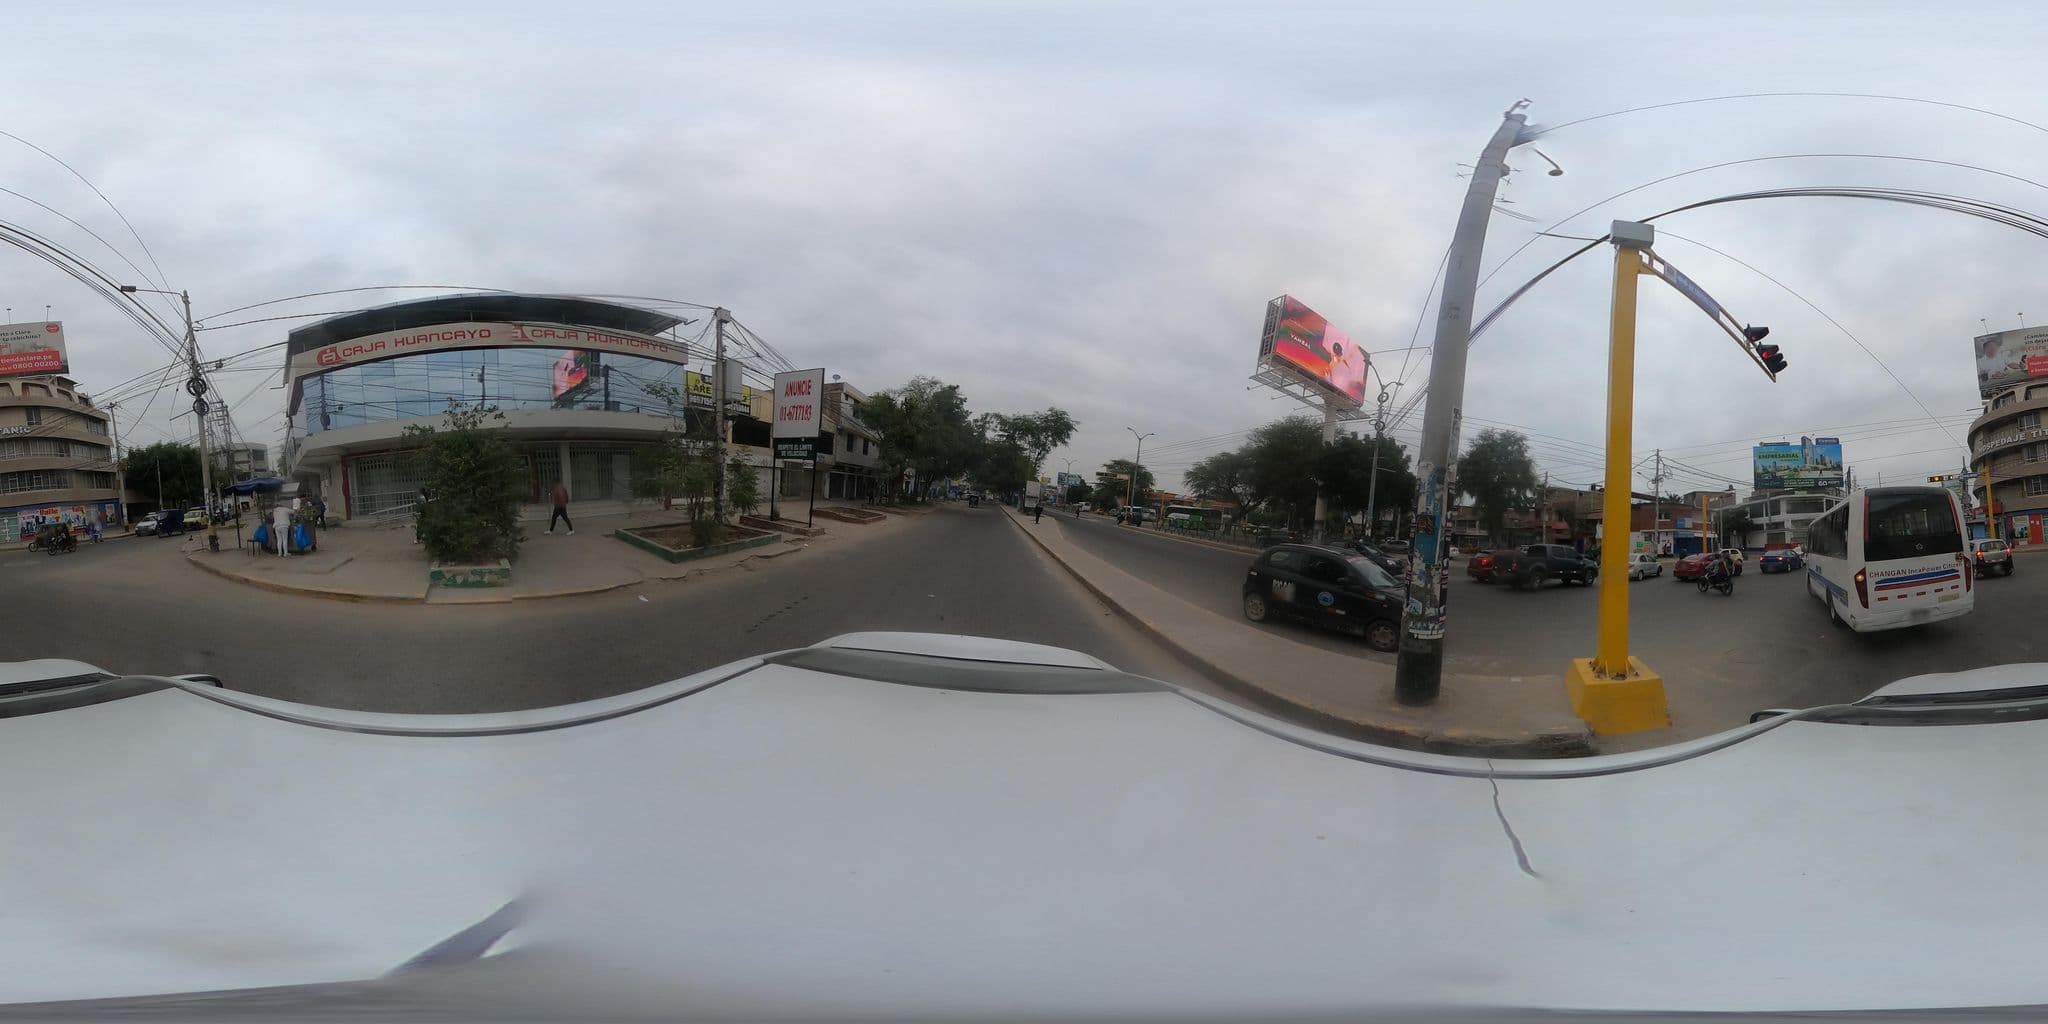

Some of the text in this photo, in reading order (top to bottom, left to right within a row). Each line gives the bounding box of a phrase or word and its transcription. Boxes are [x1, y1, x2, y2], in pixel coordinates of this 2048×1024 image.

[343, 328, 492, 357] CAJA HUANCAYO
[531, 329, 669, 353] CAJA HUANCAYO
[785, 379, 812, 397] ANUNCIE
[1870, 568, 1907, 578] CHANGAN
